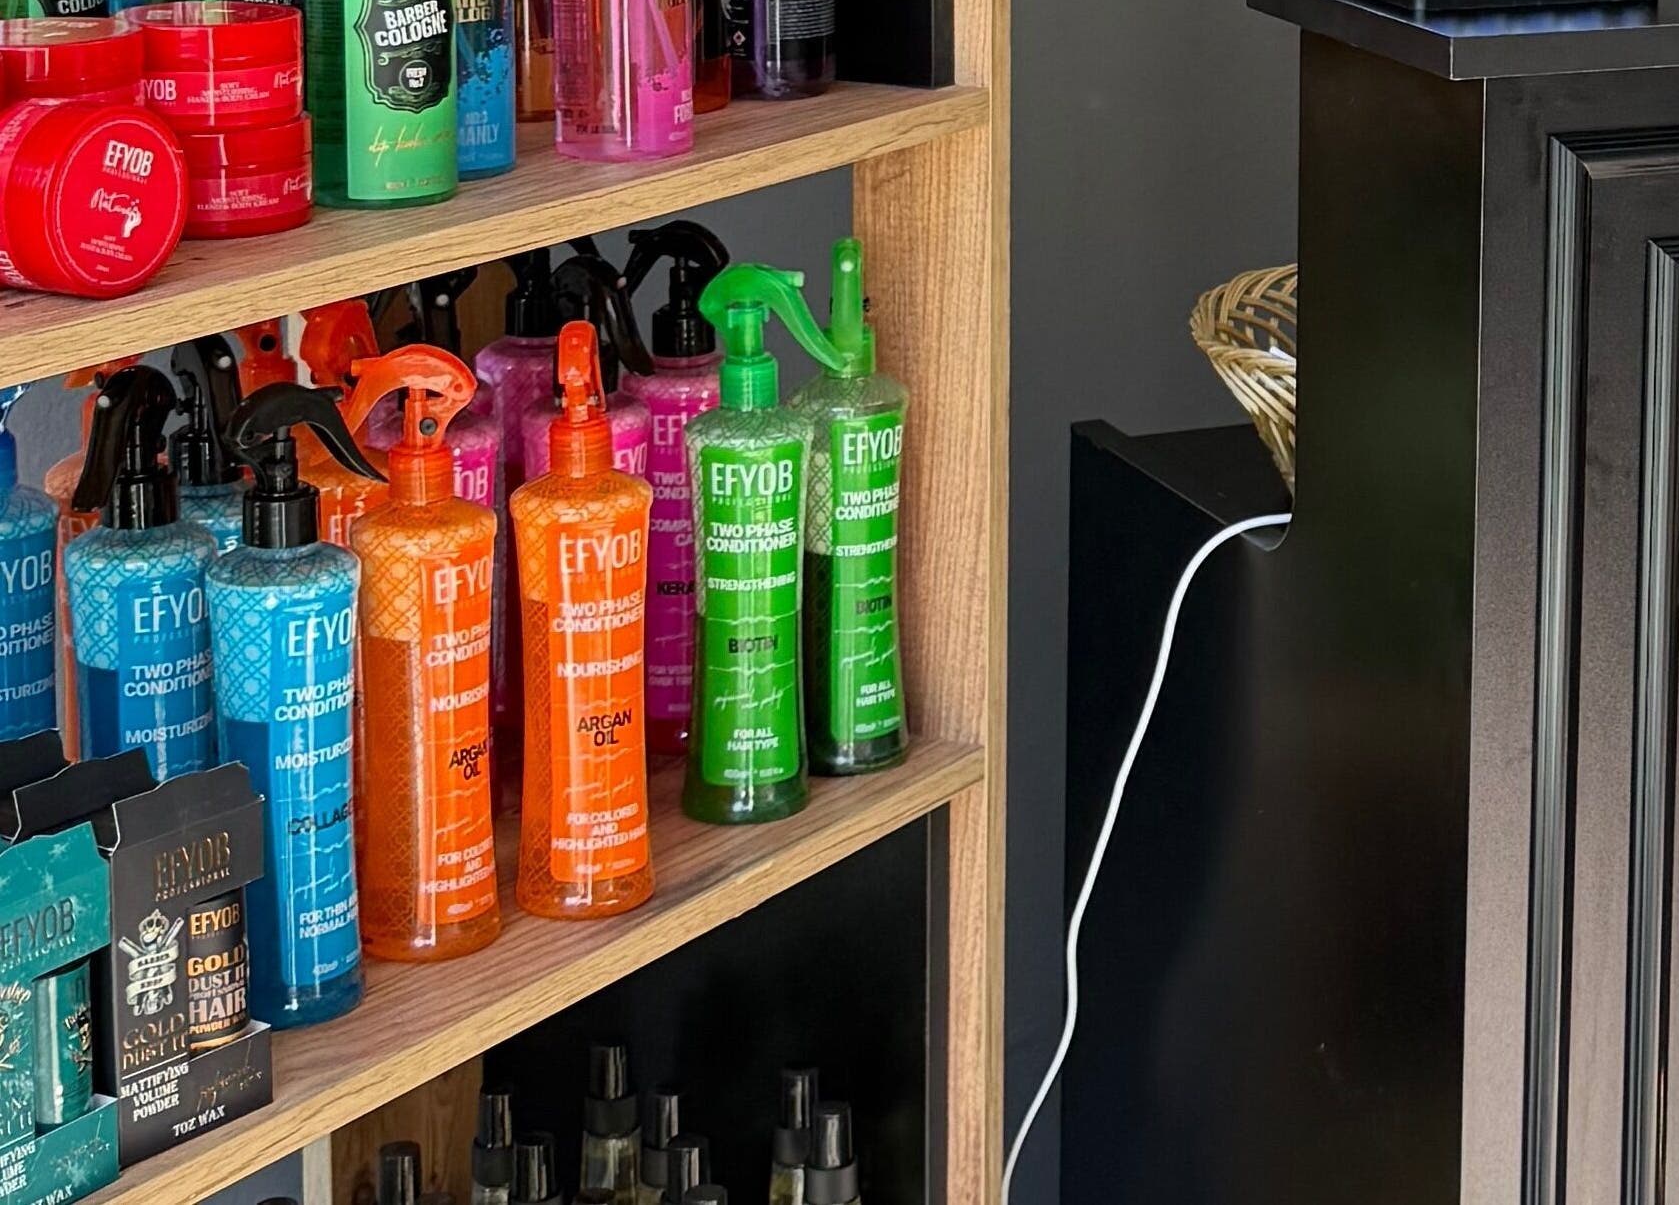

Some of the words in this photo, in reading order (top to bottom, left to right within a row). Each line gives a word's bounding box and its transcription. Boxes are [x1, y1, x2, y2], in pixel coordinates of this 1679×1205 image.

[374, 9, 449, 47] COLOGNE
[384, 0, 439, 30] BARBER
[138, 78, 177, 101] YOB
[103, 139, 154, 177] EFYOB
[843, 425, 903, 466] EFYOB
[711, 459, 793, 496] EFYOB
[841, 490, 872, 506] TWO
[706, 531, 797, 553] CONDITIONER
[711, 522, 744, 538] TWO
[745, 516, 795, 538] PHASE
[559, 528, 642, 574] EFYOB
[0, 549, 53, 594] YOB
[434, 555, 492, 605] EFYO
[657, 581, 695, 596] KERA
[558, 602, 597, 618] TWO
[432, 629, 470, 650] TWO
[131, 661, 173, 681] TWO
[175, 648, 213, 675] PHAS
[124, 666, 213, 697] CONDITION
[283, 684, 326, 704] TWO
[327, 668, 355, 694] PHA
[274, 687, 355, 722] CONDITIO
[577, 708, 632, 733] ARGAN
[125, 708, 214, 744] MOISTURIZIN
[593, 730, 619, 747] OIL
[733, 728, 754, 739] FOR
[275, 734, 354, 770] MOISTURIZ
[463, 761, 481, 781] OIL
[288, 795, 353, 836] COLLAG
[155, 831, 231, 891] EFYOB
[190, 903, 241, 937] EFYOB
[187, 944, 244, 978] GOLD
[188, 970, 231, 992] DUST
[189, 988, 246, 1025] HAIR
[123, 1012, 186, 1050] GOLD
[120, 1062, 190, 1100] MATTIFYING
[133, 1080, 179, 1108] VOLUME
[132, 1094, 180, 1122] POWDER
[172, 1116, 197, 1137] TOZ
[197, 1104, 227, 1126] WAX
[0, 1141, 36, 1168] IFYING
